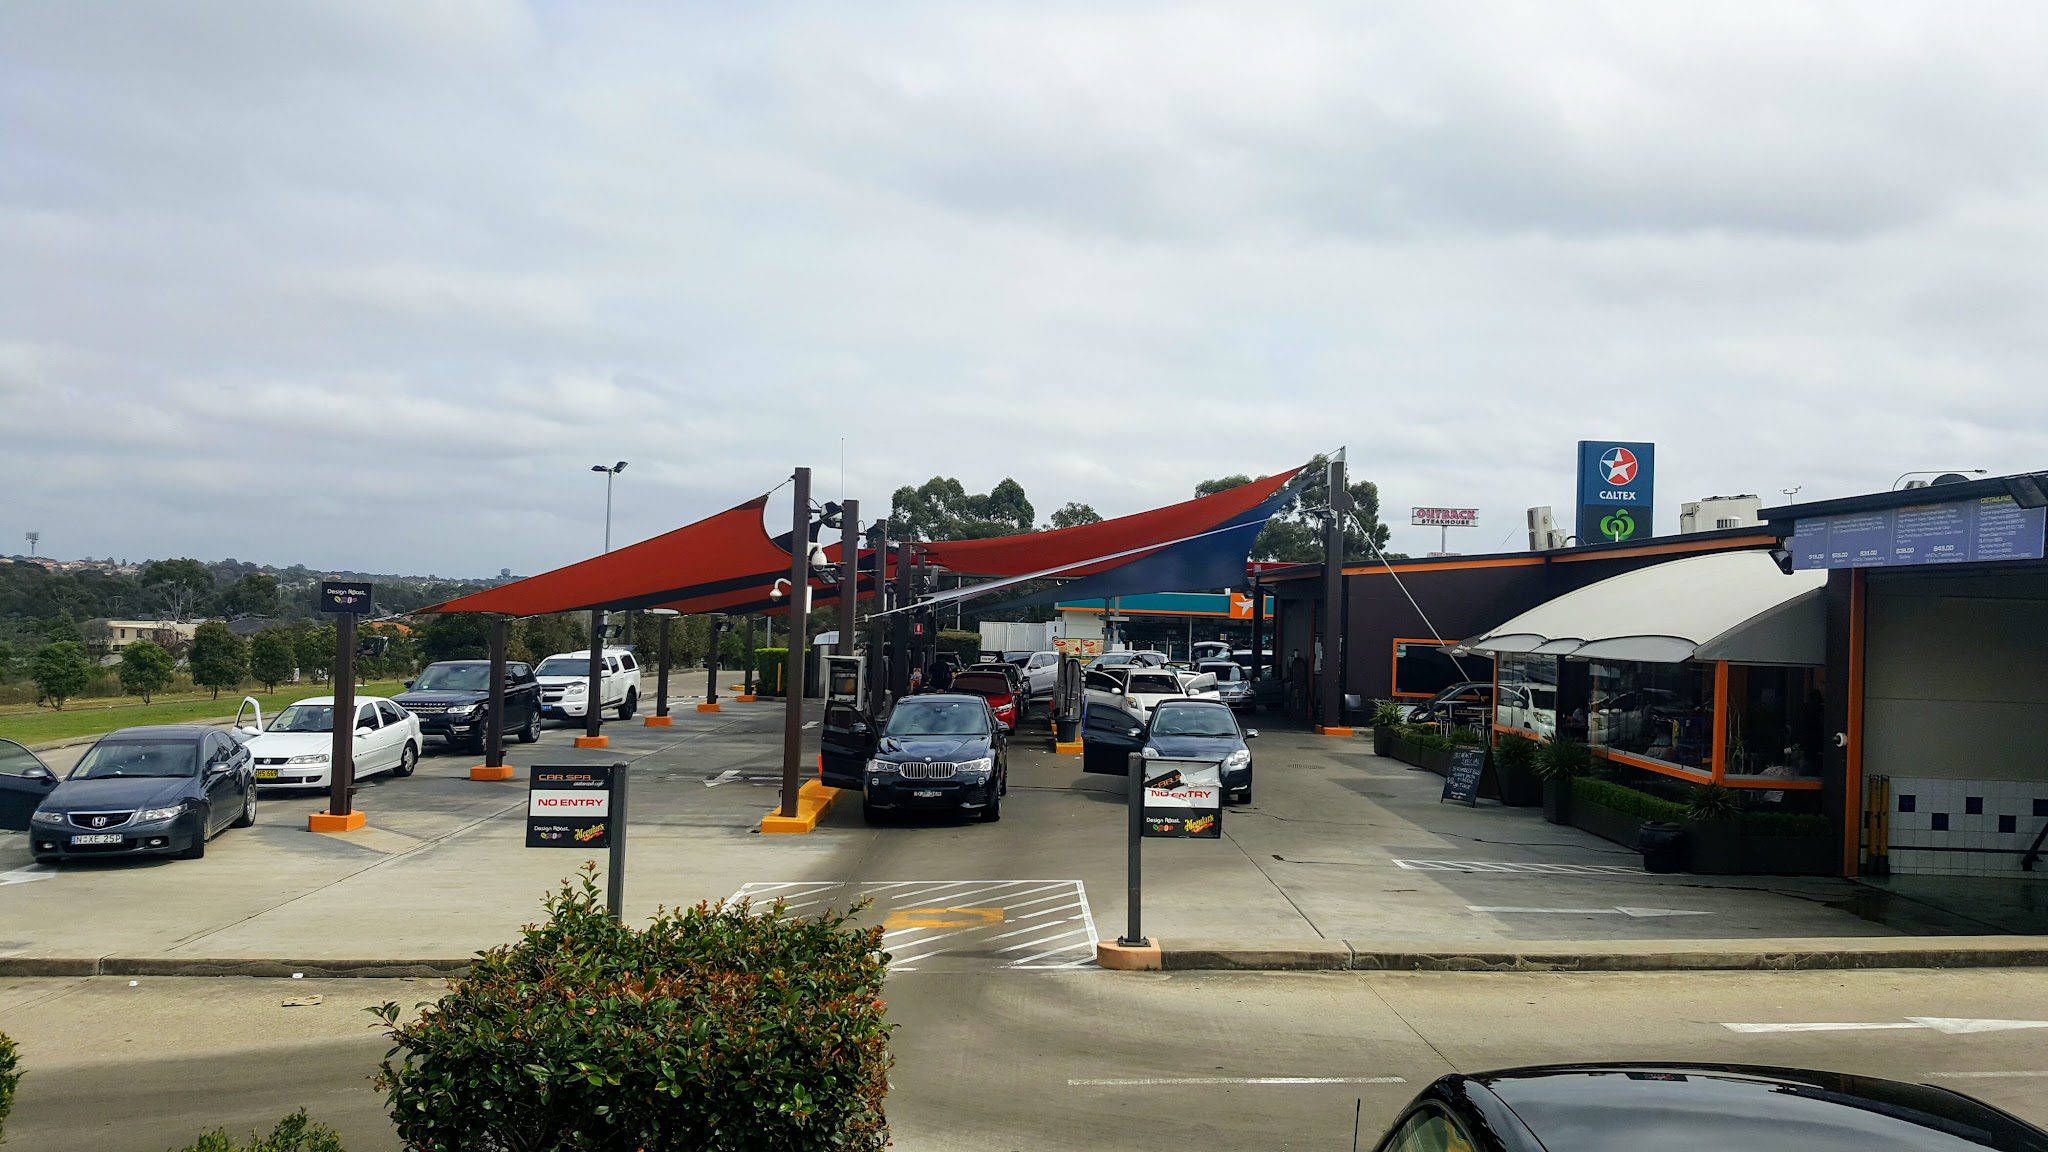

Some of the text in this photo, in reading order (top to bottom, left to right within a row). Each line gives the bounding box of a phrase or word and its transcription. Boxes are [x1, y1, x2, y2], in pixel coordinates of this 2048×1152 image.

[1599, 490, 1637, 500] CALTEX
[1416, 508, 1476, 520] OUTBACK
[1171, 790, 1212, 798] ENTRY
